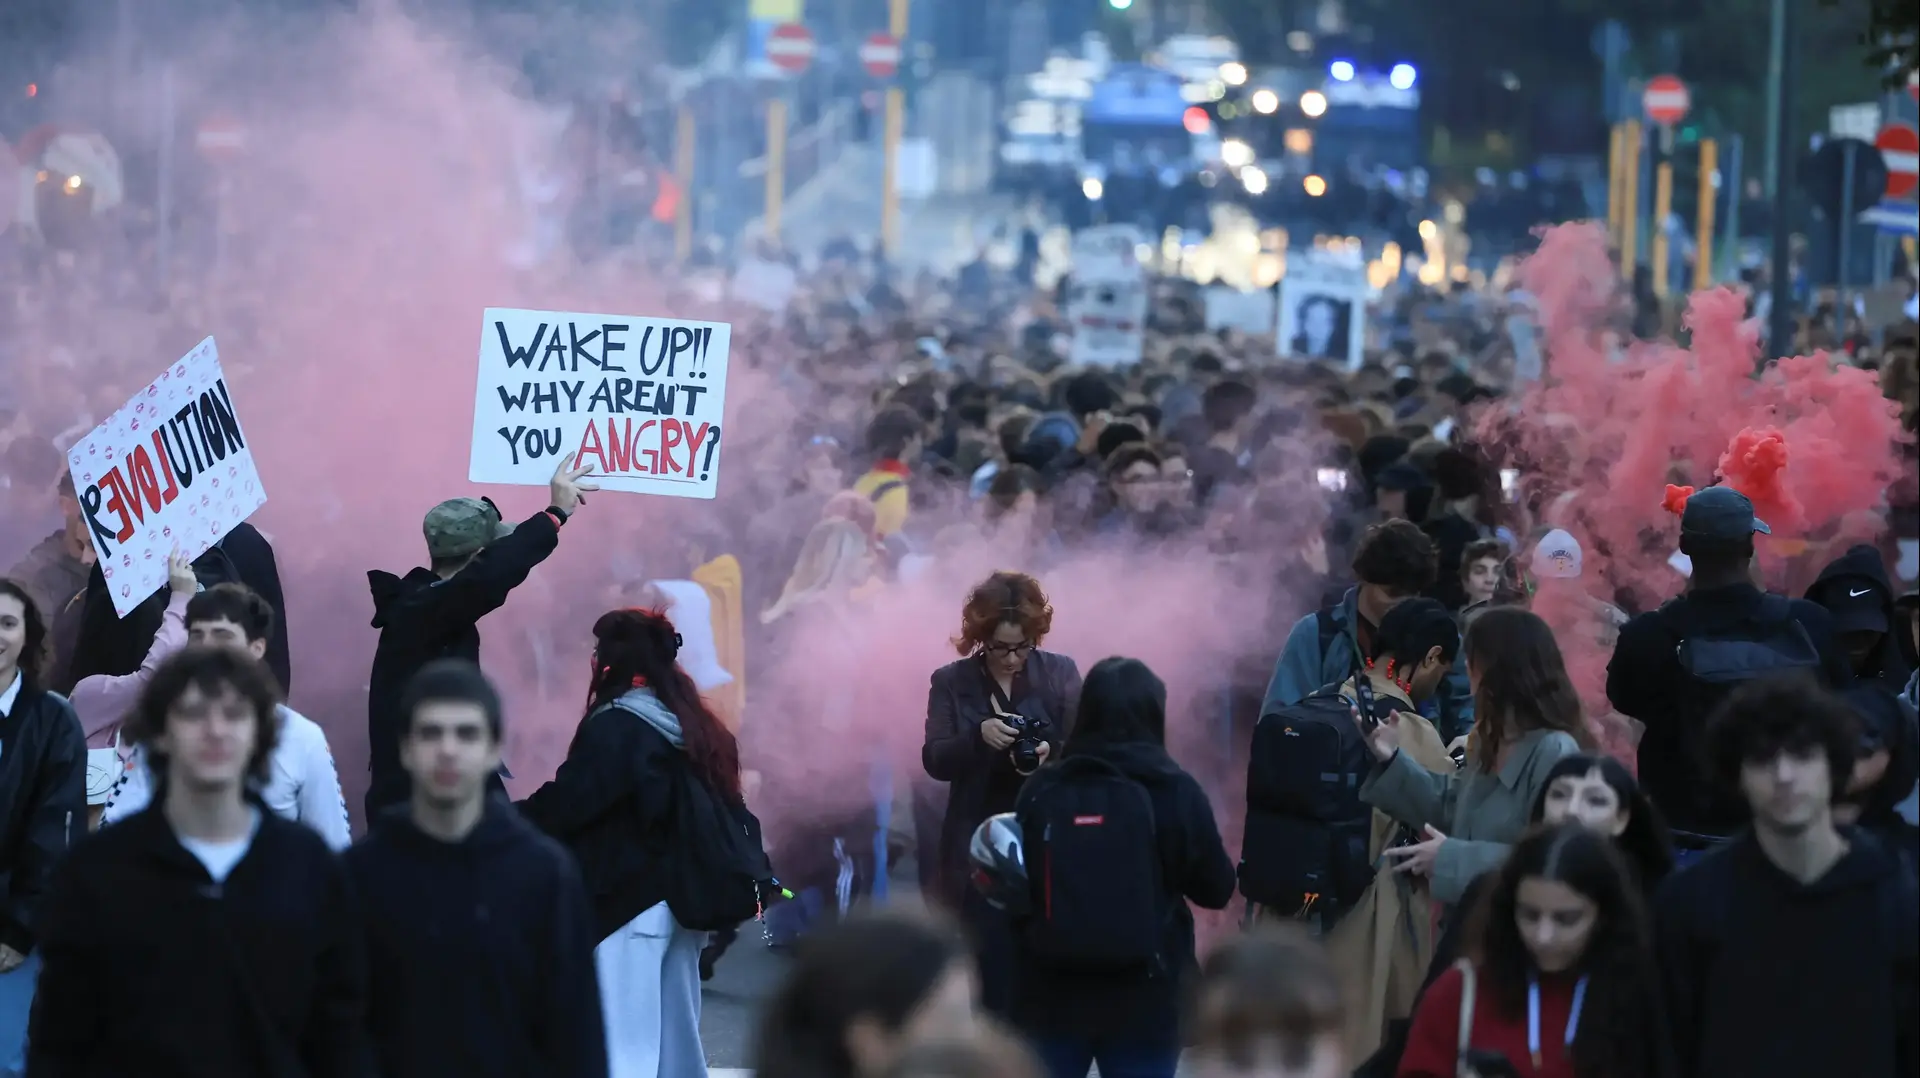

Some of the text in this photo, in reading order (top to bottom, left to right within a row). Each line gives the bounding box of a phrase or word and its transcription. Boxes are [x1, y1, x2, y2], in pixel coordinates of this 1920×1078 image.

[494, 321, 713, 379] WAKE UP!!
[497, 377, 707, 416] WHY AREN'T
[79, 378, 245, 559] REVOLUTION
[497, 417, 721, 482] YOU ANGRY?
